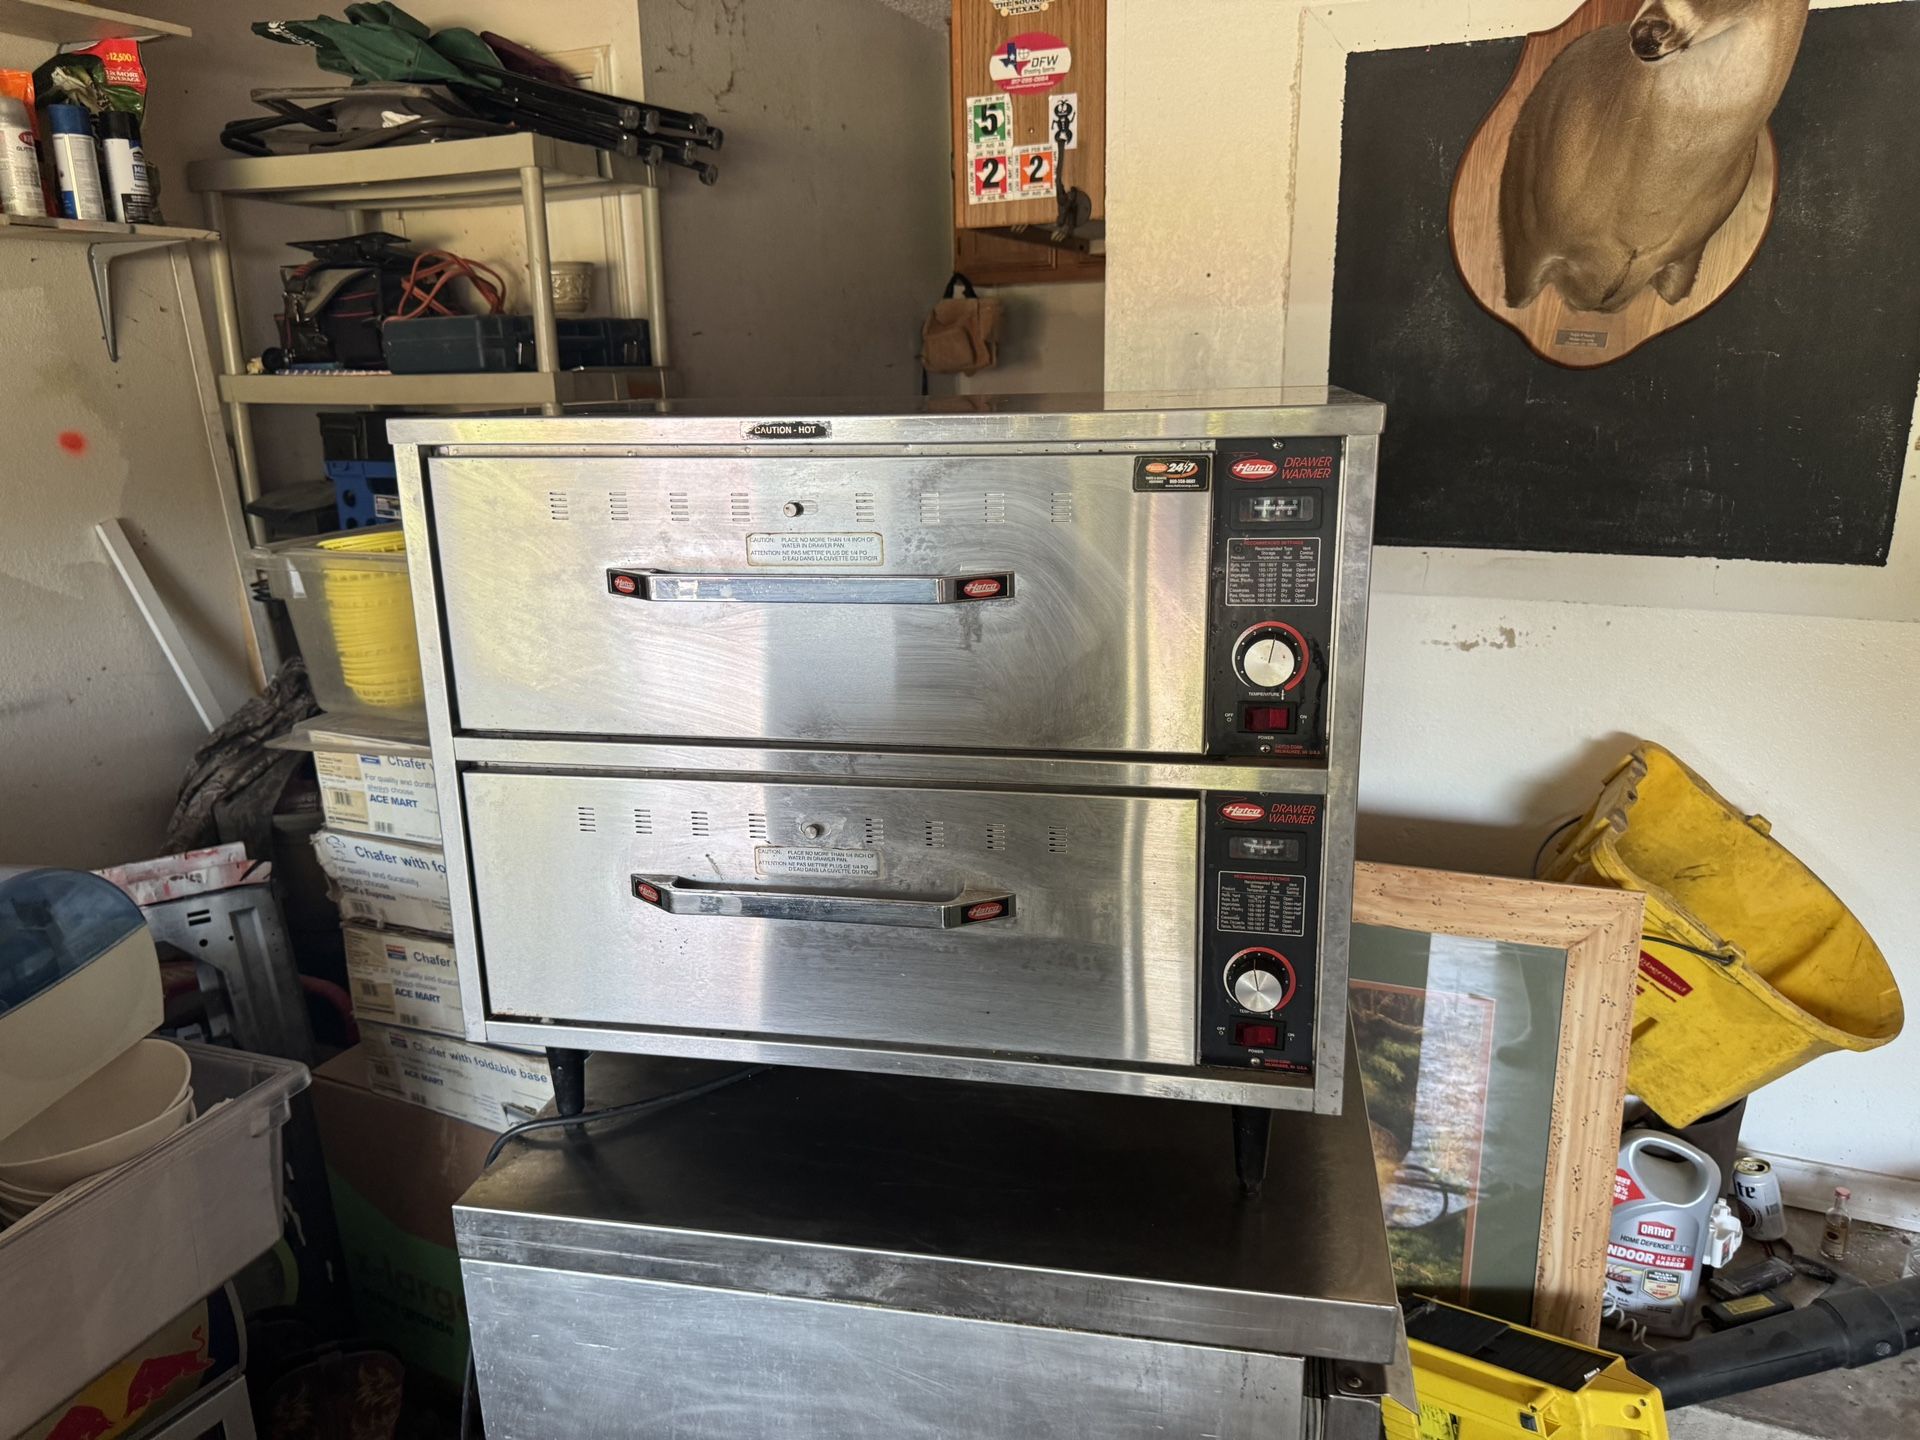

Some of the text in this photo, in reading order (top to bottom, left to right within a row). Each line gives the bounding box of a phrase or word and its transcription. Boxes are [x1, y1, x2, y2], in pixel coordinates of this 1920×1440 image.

[1009, 5, 1040, 14] TEXAS
[1031, 55, 1058, 68] DFW
[981, 104, 998, 135] 5
[982, 158, 1000, 189] 2
[1029, 155, 1043, 183] 2
[754, 426, 792, 434] CAUTION
[799, 426, 816, 434] HOT
[1167, 460, 1196, 474] 24/7
[1232, 463, 1274, 475] Hatco
[1284, 456, 1332, 468] DRAWER
[1281, 468, 1332, 479] WARMER
[964, 583, 998, 593] Hatco
[387, 755, 426, 770] Chafer
[365, 773, 375, 781] For
[377, 776, 399, 786] quality
[399, 778, 413, 786] and
[370, 794, 419, 808] ACE MART
[1223, 806, 1262, 817] Hatco
[1271, 803, 1317, 815] DRAWER
[1269, 813, 1316, 825] WARMER
[354, 846, 397, 864] Chafer
[400, 857, 430, 871] with
[970, 904, 1000, 917] Hatco
[413, 951, 450, 967] Chafer
[395, 988, 440, 1003] ACE MART
[412, 1041, 446, 1059] Cafer
[450, 1050, 472, 1065] with
[474, 1056, 517, 1077] foldable
[520, 1068, 548, 1083] base
[404, 1069, 444, 1087] ACE MART
[1737, 1181, 1757, 1200] te
[1641, 1224, 1671, 1238] ORTHO
[1620, 1234, 1639, 1244] HOME
[1640, 1239, 1669, 1250] DEFENSE
[1607, 1244, 1655, 1264] NDOOR
[1657, 1255, 1687, 1263] INSECT
[1655, 1260, 1685, 1268] BARRIER
